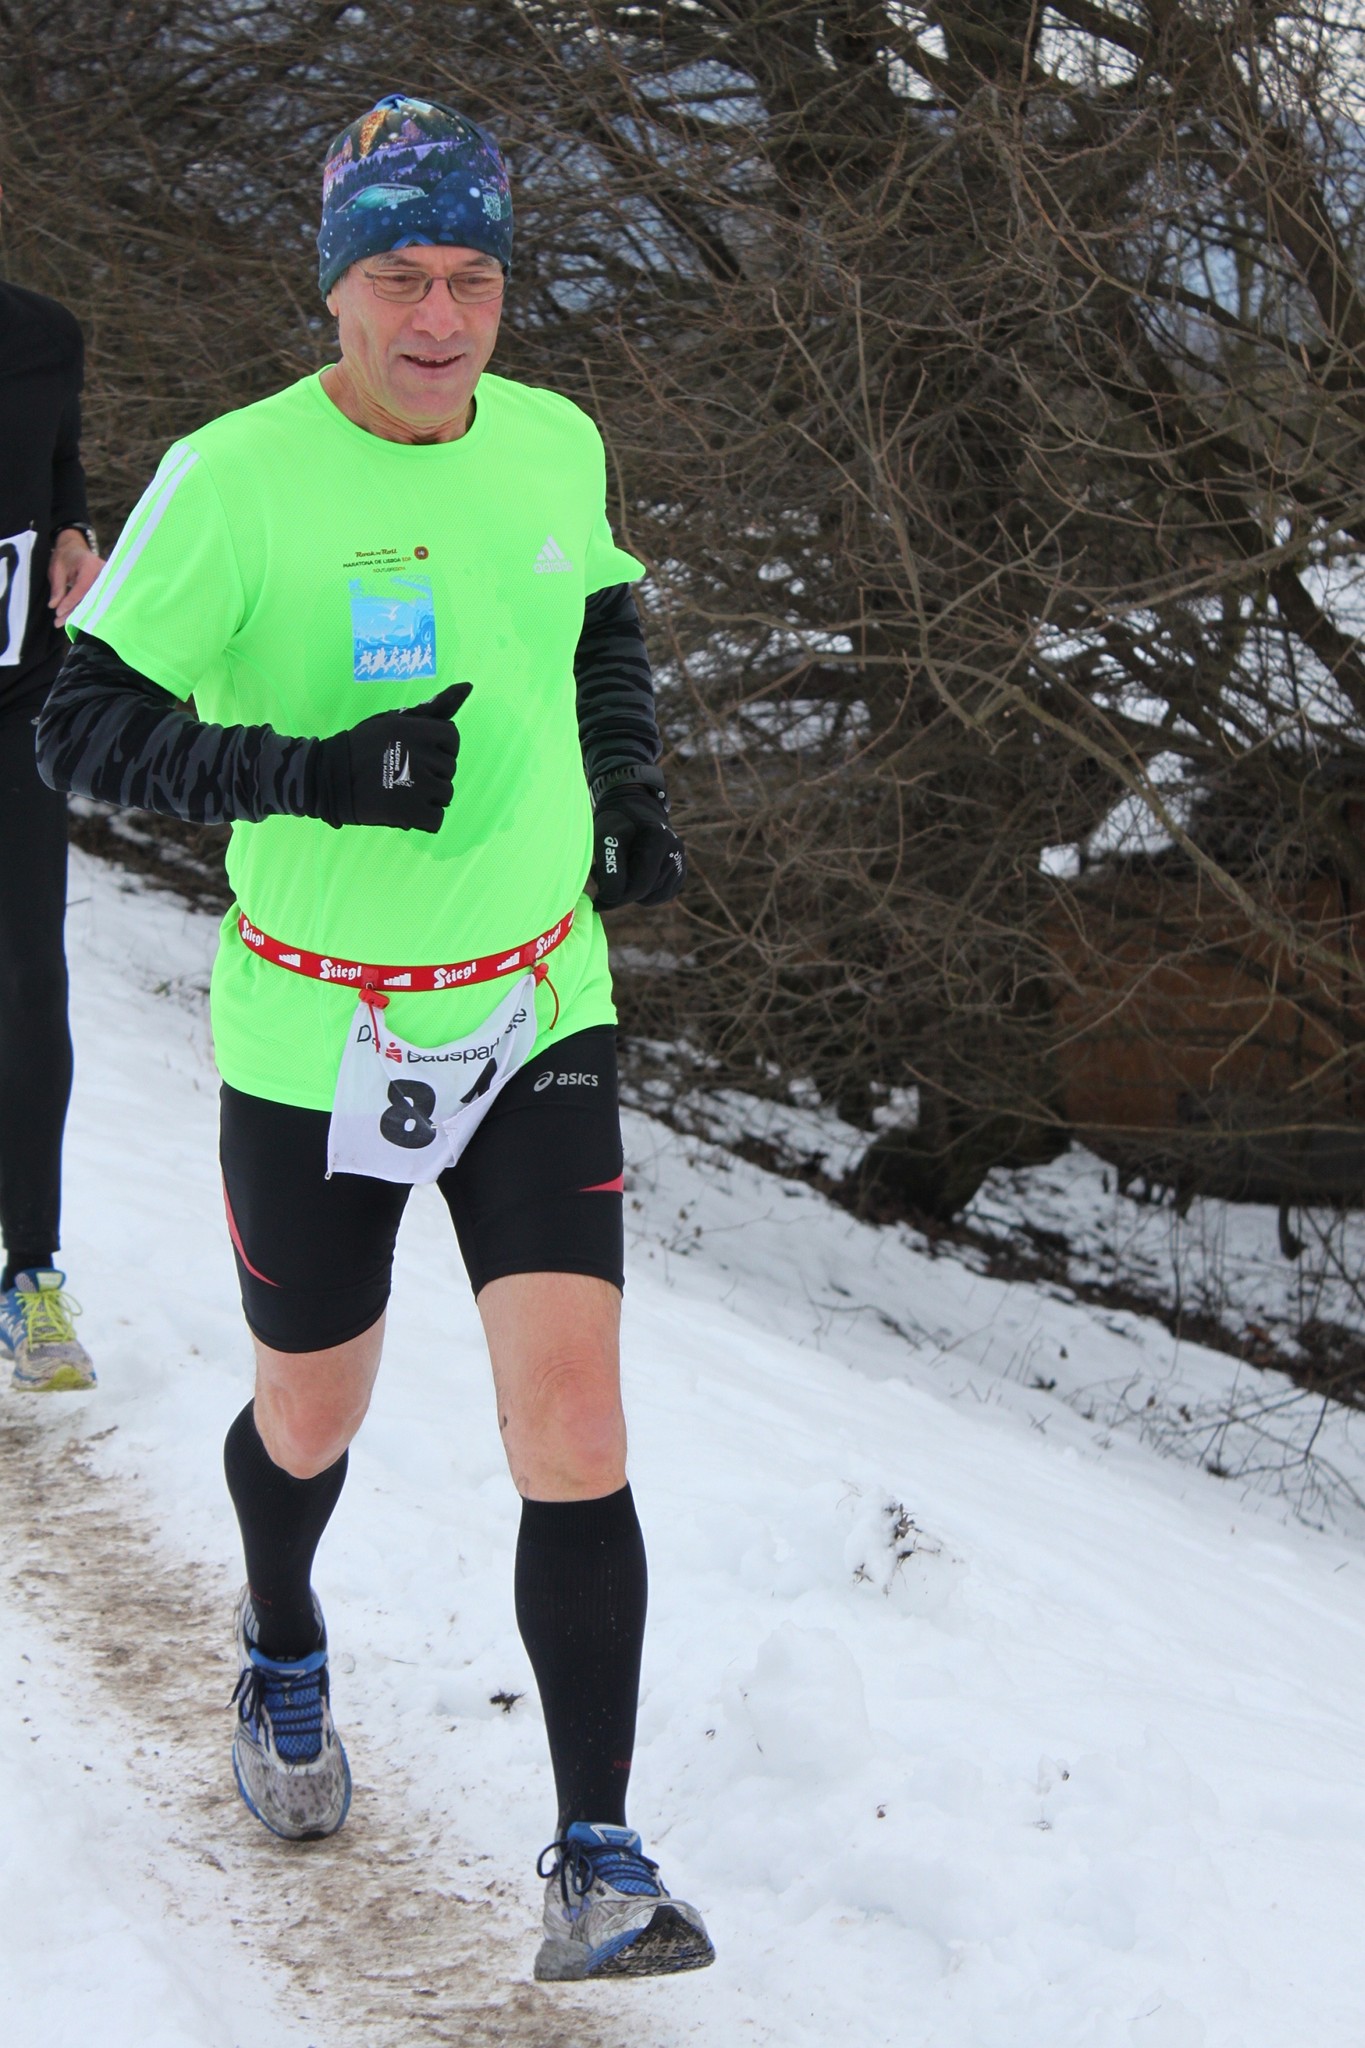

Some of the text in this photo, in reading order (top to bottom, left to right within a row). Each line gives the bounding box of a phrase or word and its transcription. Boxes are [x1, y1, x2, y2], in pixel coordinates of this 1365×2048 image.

[343, 560, 373, 568] MARATONA
[533, 559, 573, 573] adidas
[241, 919, 265, 947] Stiegl
[535, 923, 562, 959] Stiegl
[319, 958, 362, 981] Stiegl
[433, 961, 477, 989] Stiegl
[556, 1072, 599, 1087] asics
